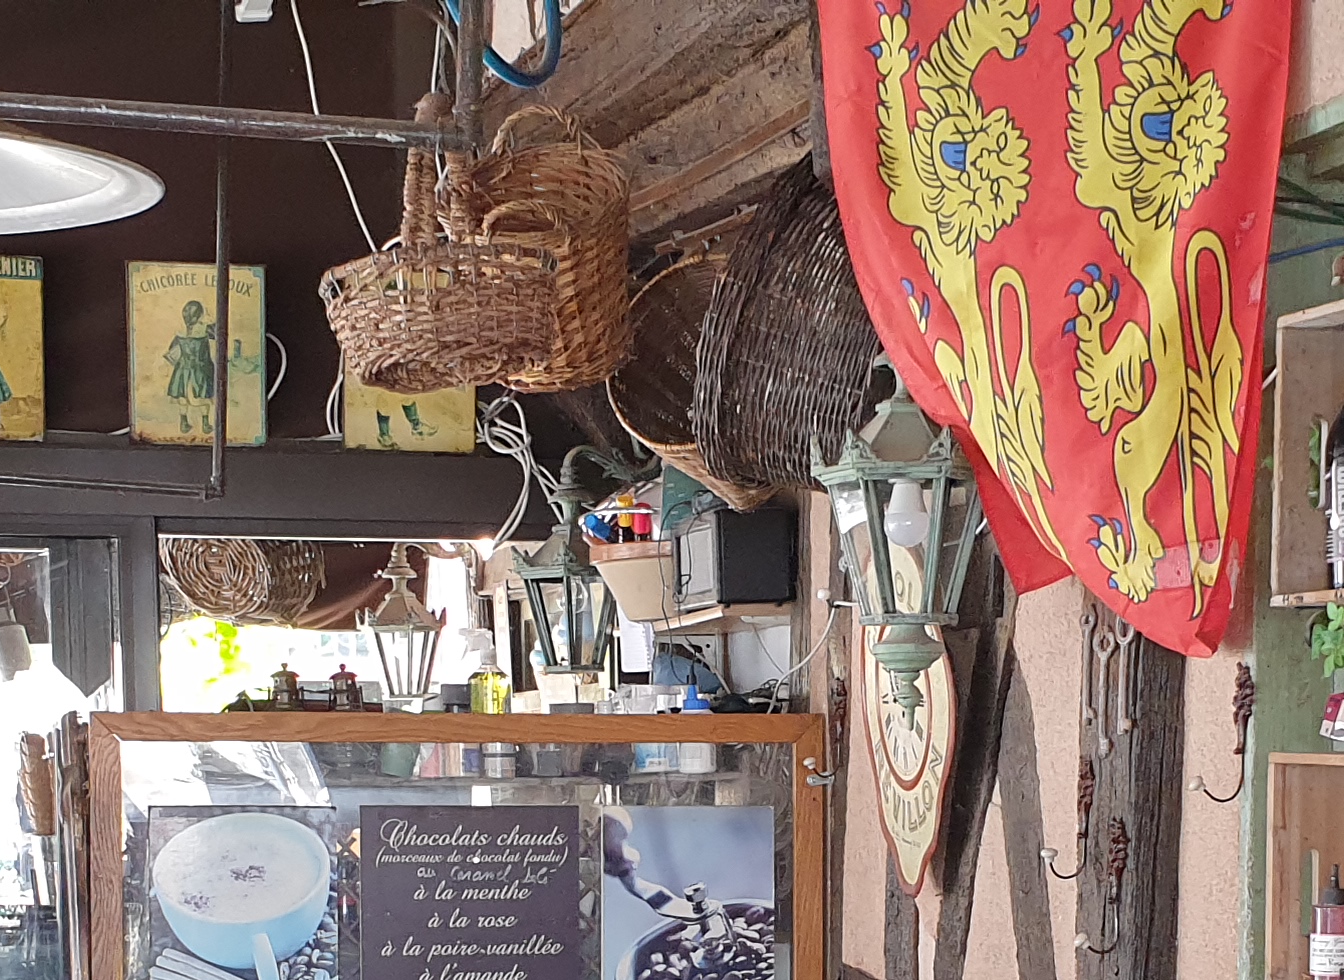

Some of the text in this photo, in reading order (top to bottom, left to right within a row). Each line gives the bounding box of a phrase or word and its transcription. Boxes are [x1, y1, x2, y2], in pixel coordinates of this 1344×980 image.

[205, 274, 254, 297] LEOUX
[380, 818, 570, 852] Chocolats chauds
[376, 846, 569, 868] (morceaux de chocolat fondu)
[417, 867, 436, 878] au
[413, 880, 532, 900] à la menthe
[427, 908, 519, 928] à la rose
[381, 940, 396, 957] à
[402, 936, 424, 956] la
